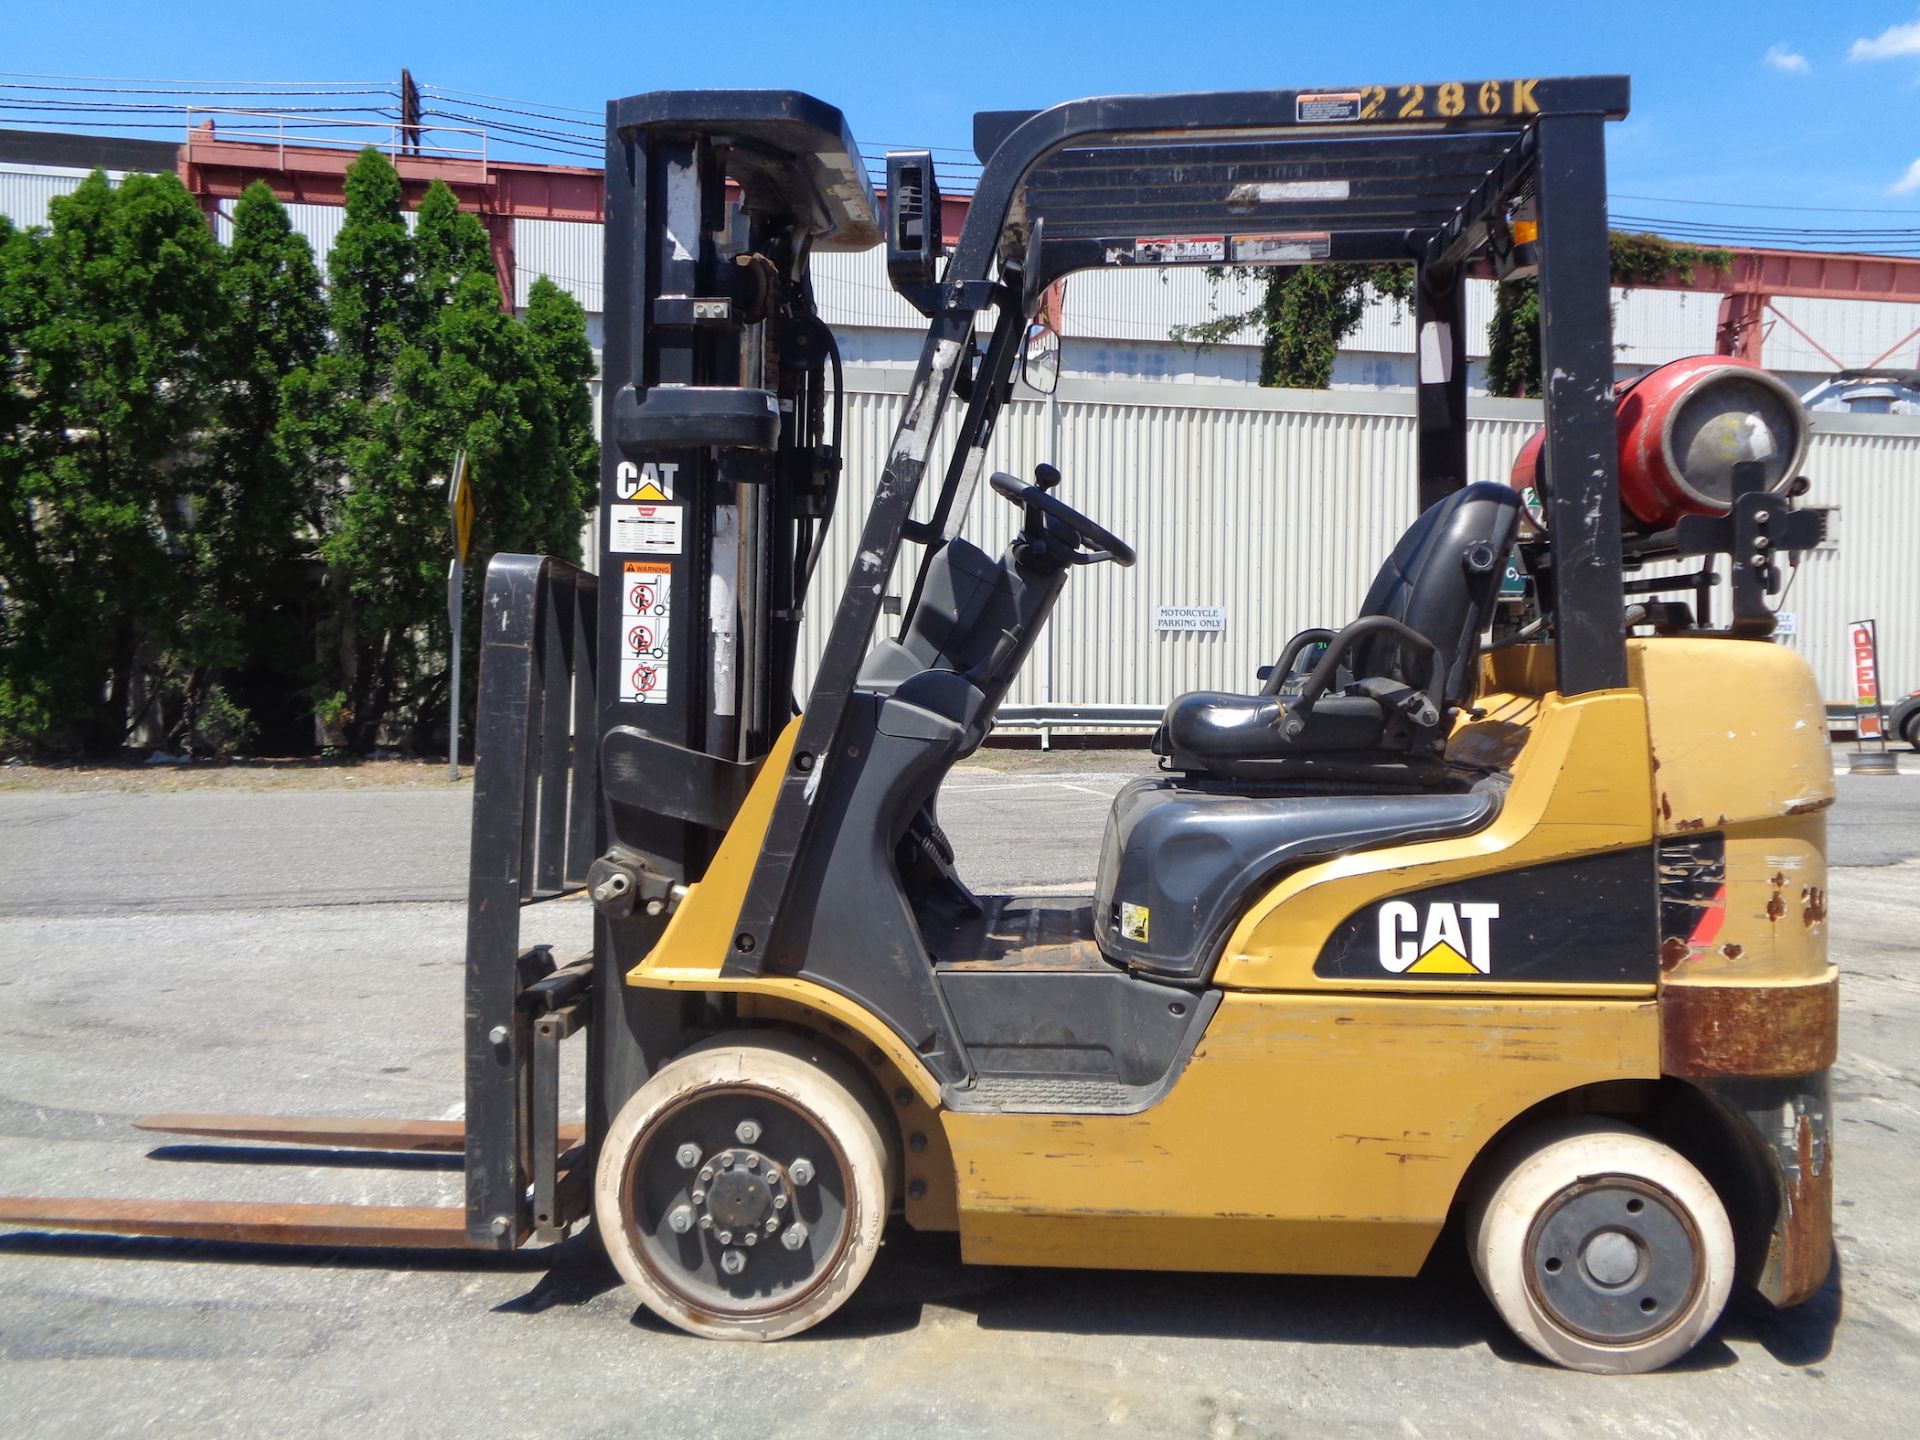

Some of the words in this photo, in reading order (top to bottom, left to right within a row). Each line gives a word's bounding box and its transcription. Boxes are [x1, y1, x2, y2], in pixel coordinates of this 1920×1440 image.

[1360, 79, 1541, 119] 2286K
[616, 461, 679, 500] CAT
[636, 565, 670, 574] WARNING
[1157, 619, 1197, 628] PARKING
[1200, 619, 1222, 628] ONLY
[1160, 609, 1219, 617] MOTORCYCLE
[1378, 900, 1500, 974] CAT
